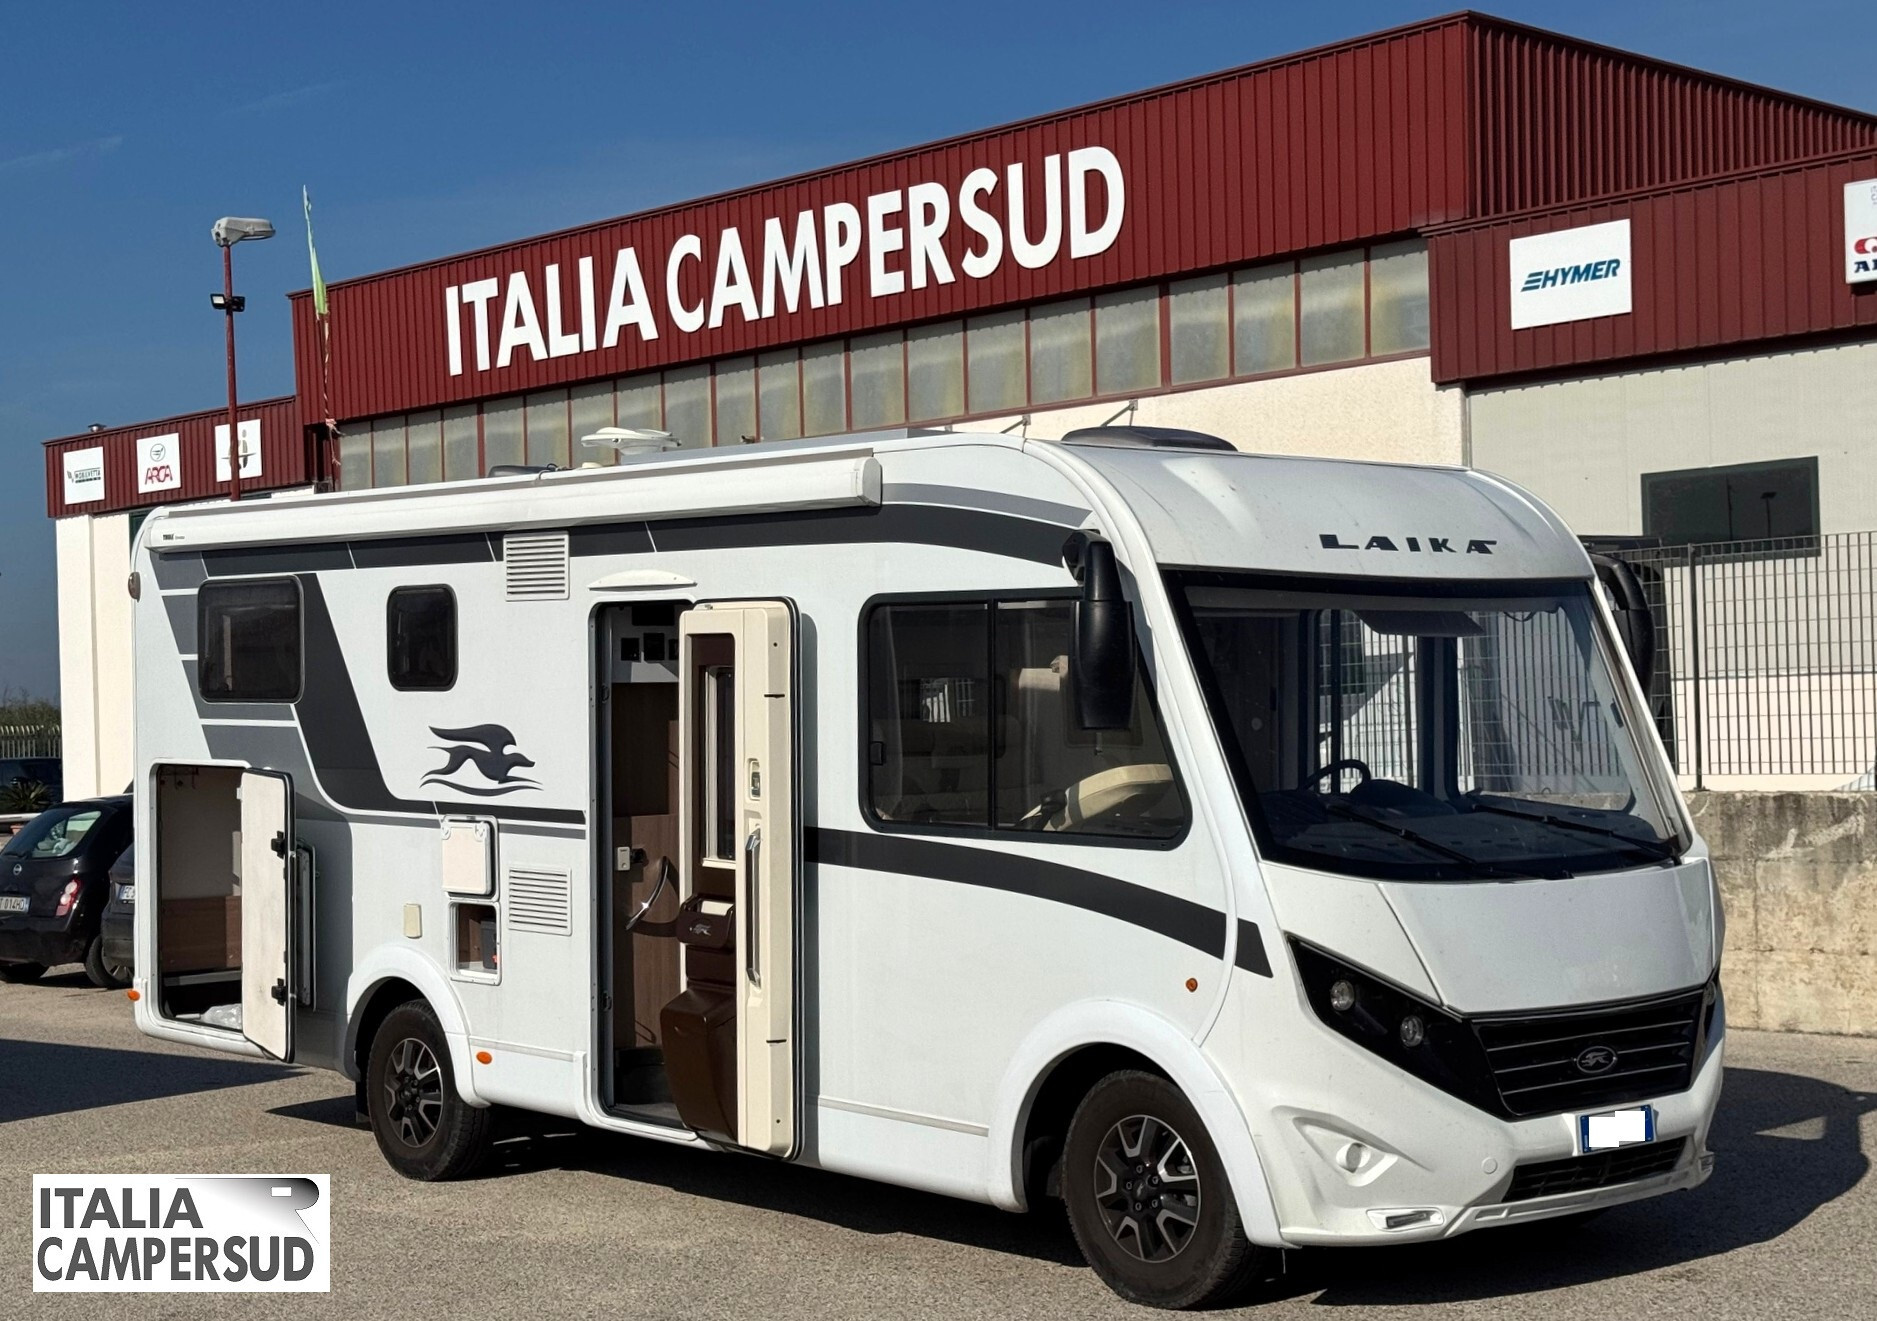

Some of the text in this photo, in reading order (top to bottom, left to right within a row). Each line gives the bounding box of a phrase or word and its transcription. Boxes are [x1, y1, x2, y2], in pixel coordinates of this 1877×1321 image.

[445, 146, 1125, 376] ITALIA CAMPERSUD
[1538, 259, 1621, 289] HYMER
[145, 464, 173, 485] ARCA
[1319, 534, 1497, 554] LAIKA
